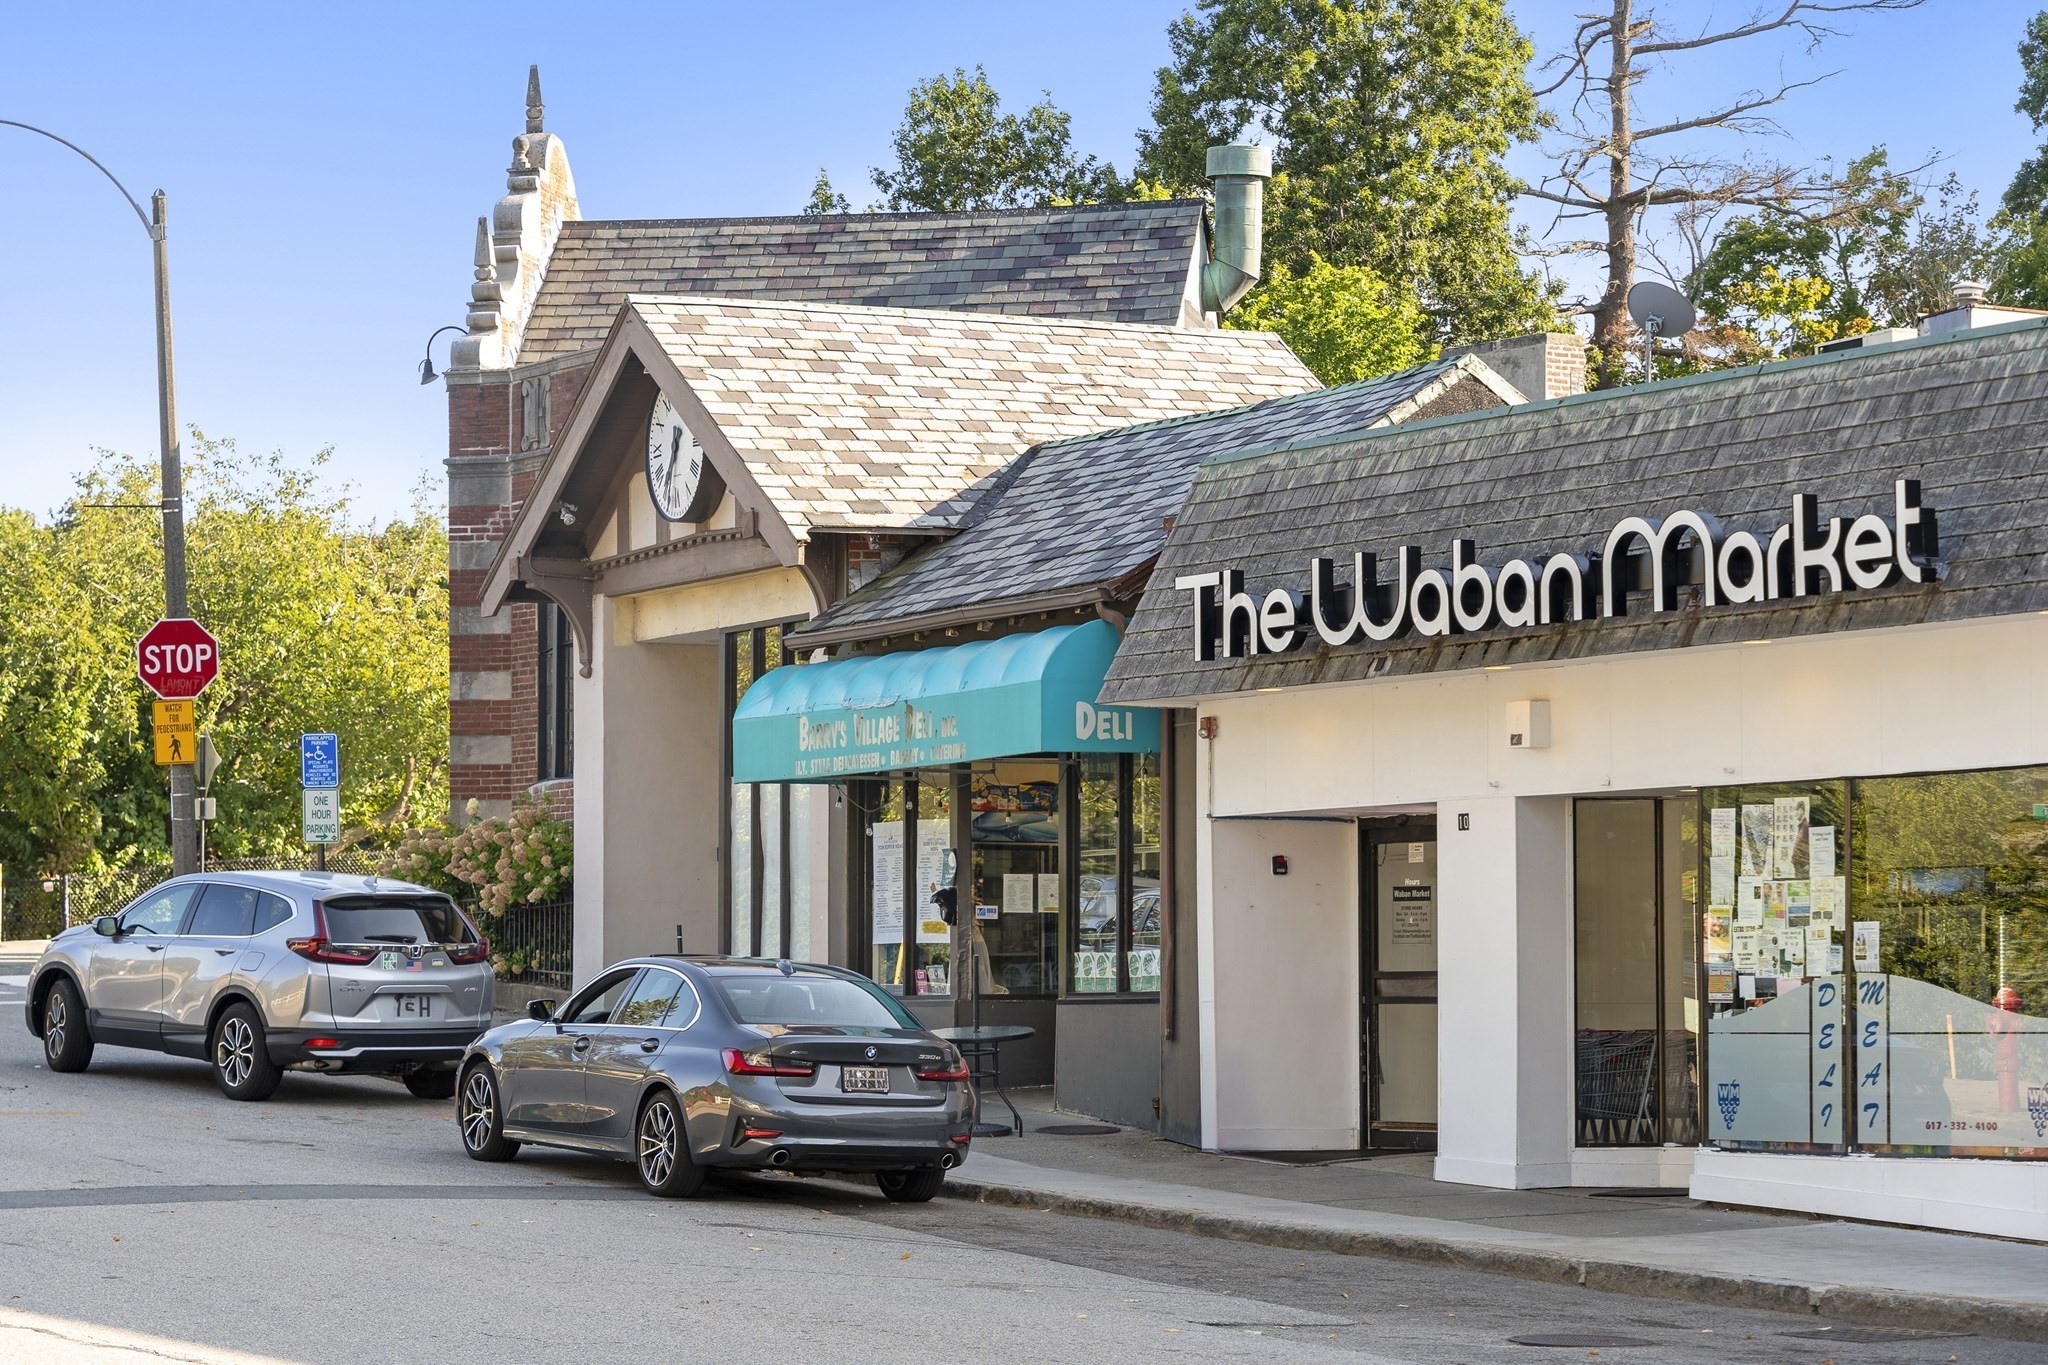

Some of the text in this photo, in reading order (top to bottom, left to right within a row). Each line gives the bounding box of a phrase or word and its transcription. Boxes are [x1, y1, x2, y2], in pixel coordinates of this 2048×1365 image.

[1175, 479, 1933, 662] The Waban Market
[144, 644, 212, 675] STOP
[164, 704, 182, 713] WATCH
[169, 715, 180, 723] FOR
[1075, 701, 1133, 741] DELI
[156, 724, 193, 734] PEDESTRIANS
[799, 715, 848, 752] BARRY'S
[853, 711, 900, 747] VILLAGE
[810, 757, 831, 773] STYLE
[833, 752, 880, 772] DELICATESSEN
[313, 796, 329, 806] ONE
[311, 809, 332, 820] HOUR
[1458, 814, 1470, 830] 10
[306, 824, 336, 834] PARKING
[1404, 878, 1420, 886] Hours
[1393, 889, 1430, 898] Waban Market
[1925, 1121, 1998, 1131] 617 332 4100
